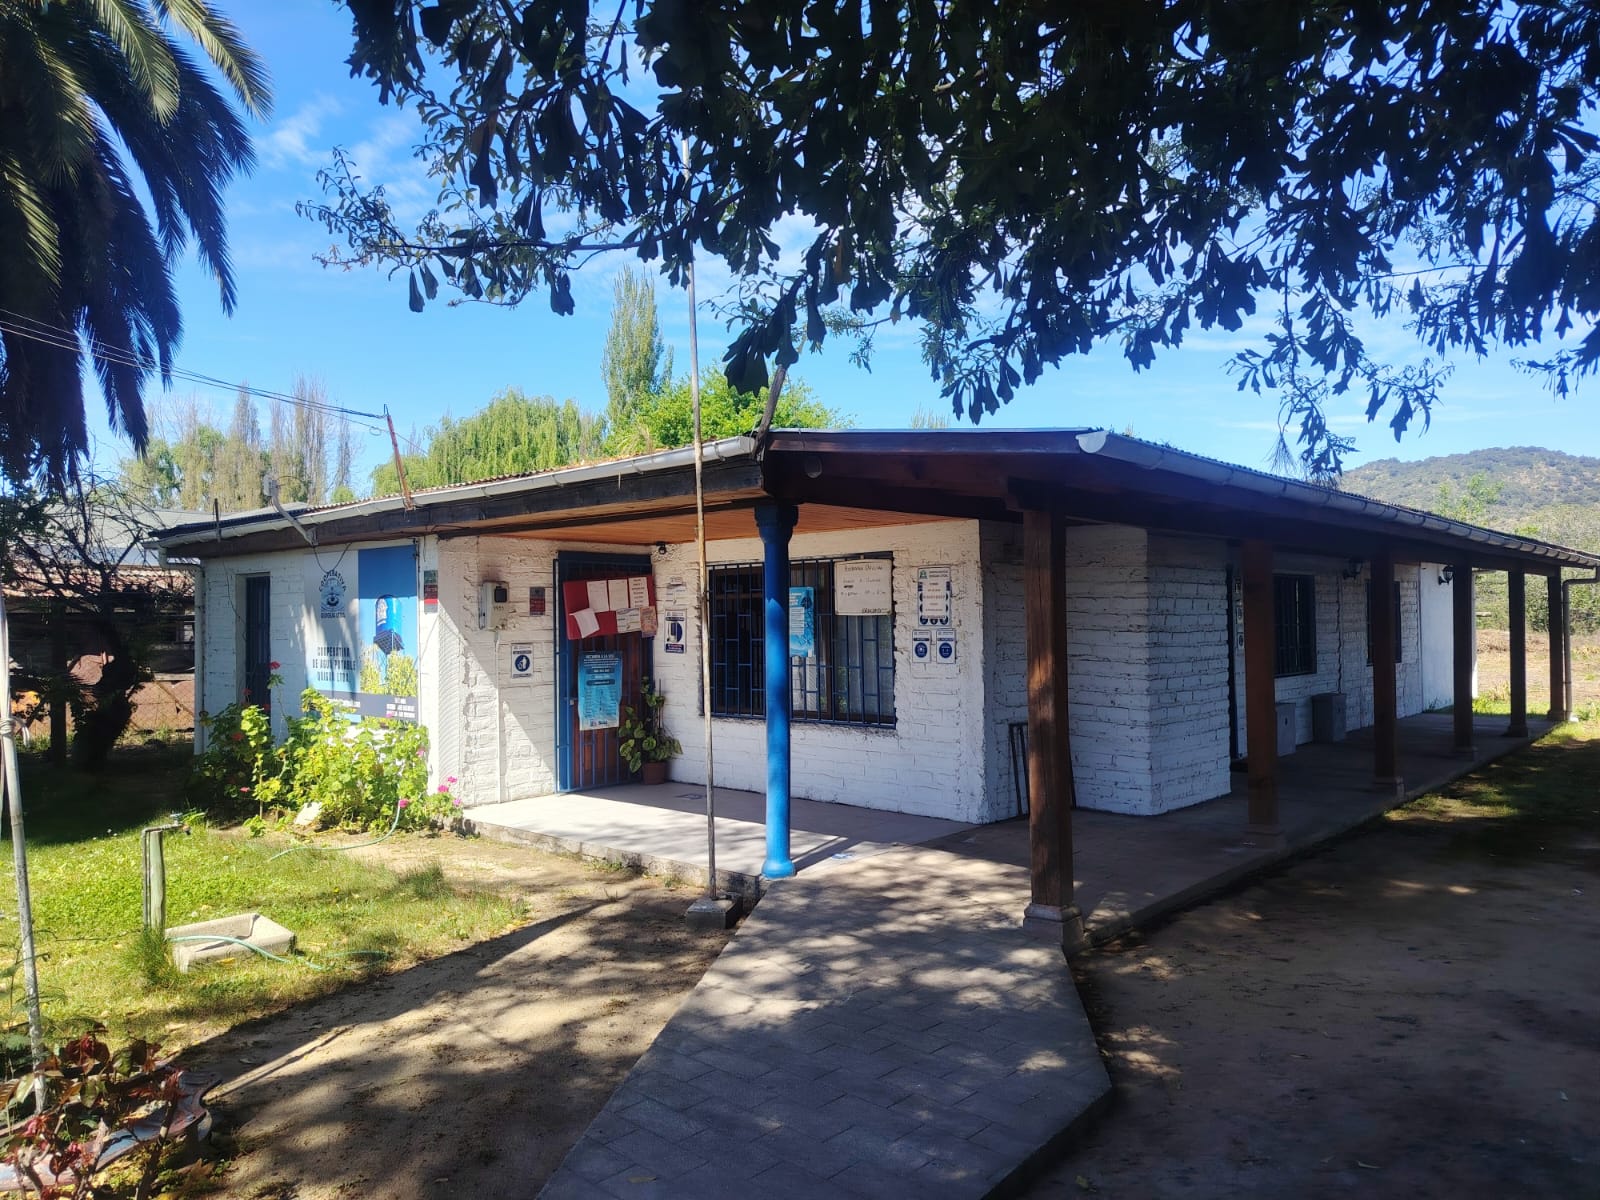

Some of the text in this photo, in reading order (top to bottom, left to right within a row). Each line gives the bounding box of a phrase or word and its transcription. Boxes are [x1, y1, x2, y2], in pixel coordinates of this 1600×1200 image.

[317, 647, 350, 657] COOPERATIVA
[312, 658, 356, 671] DE AGUA POTABLE
